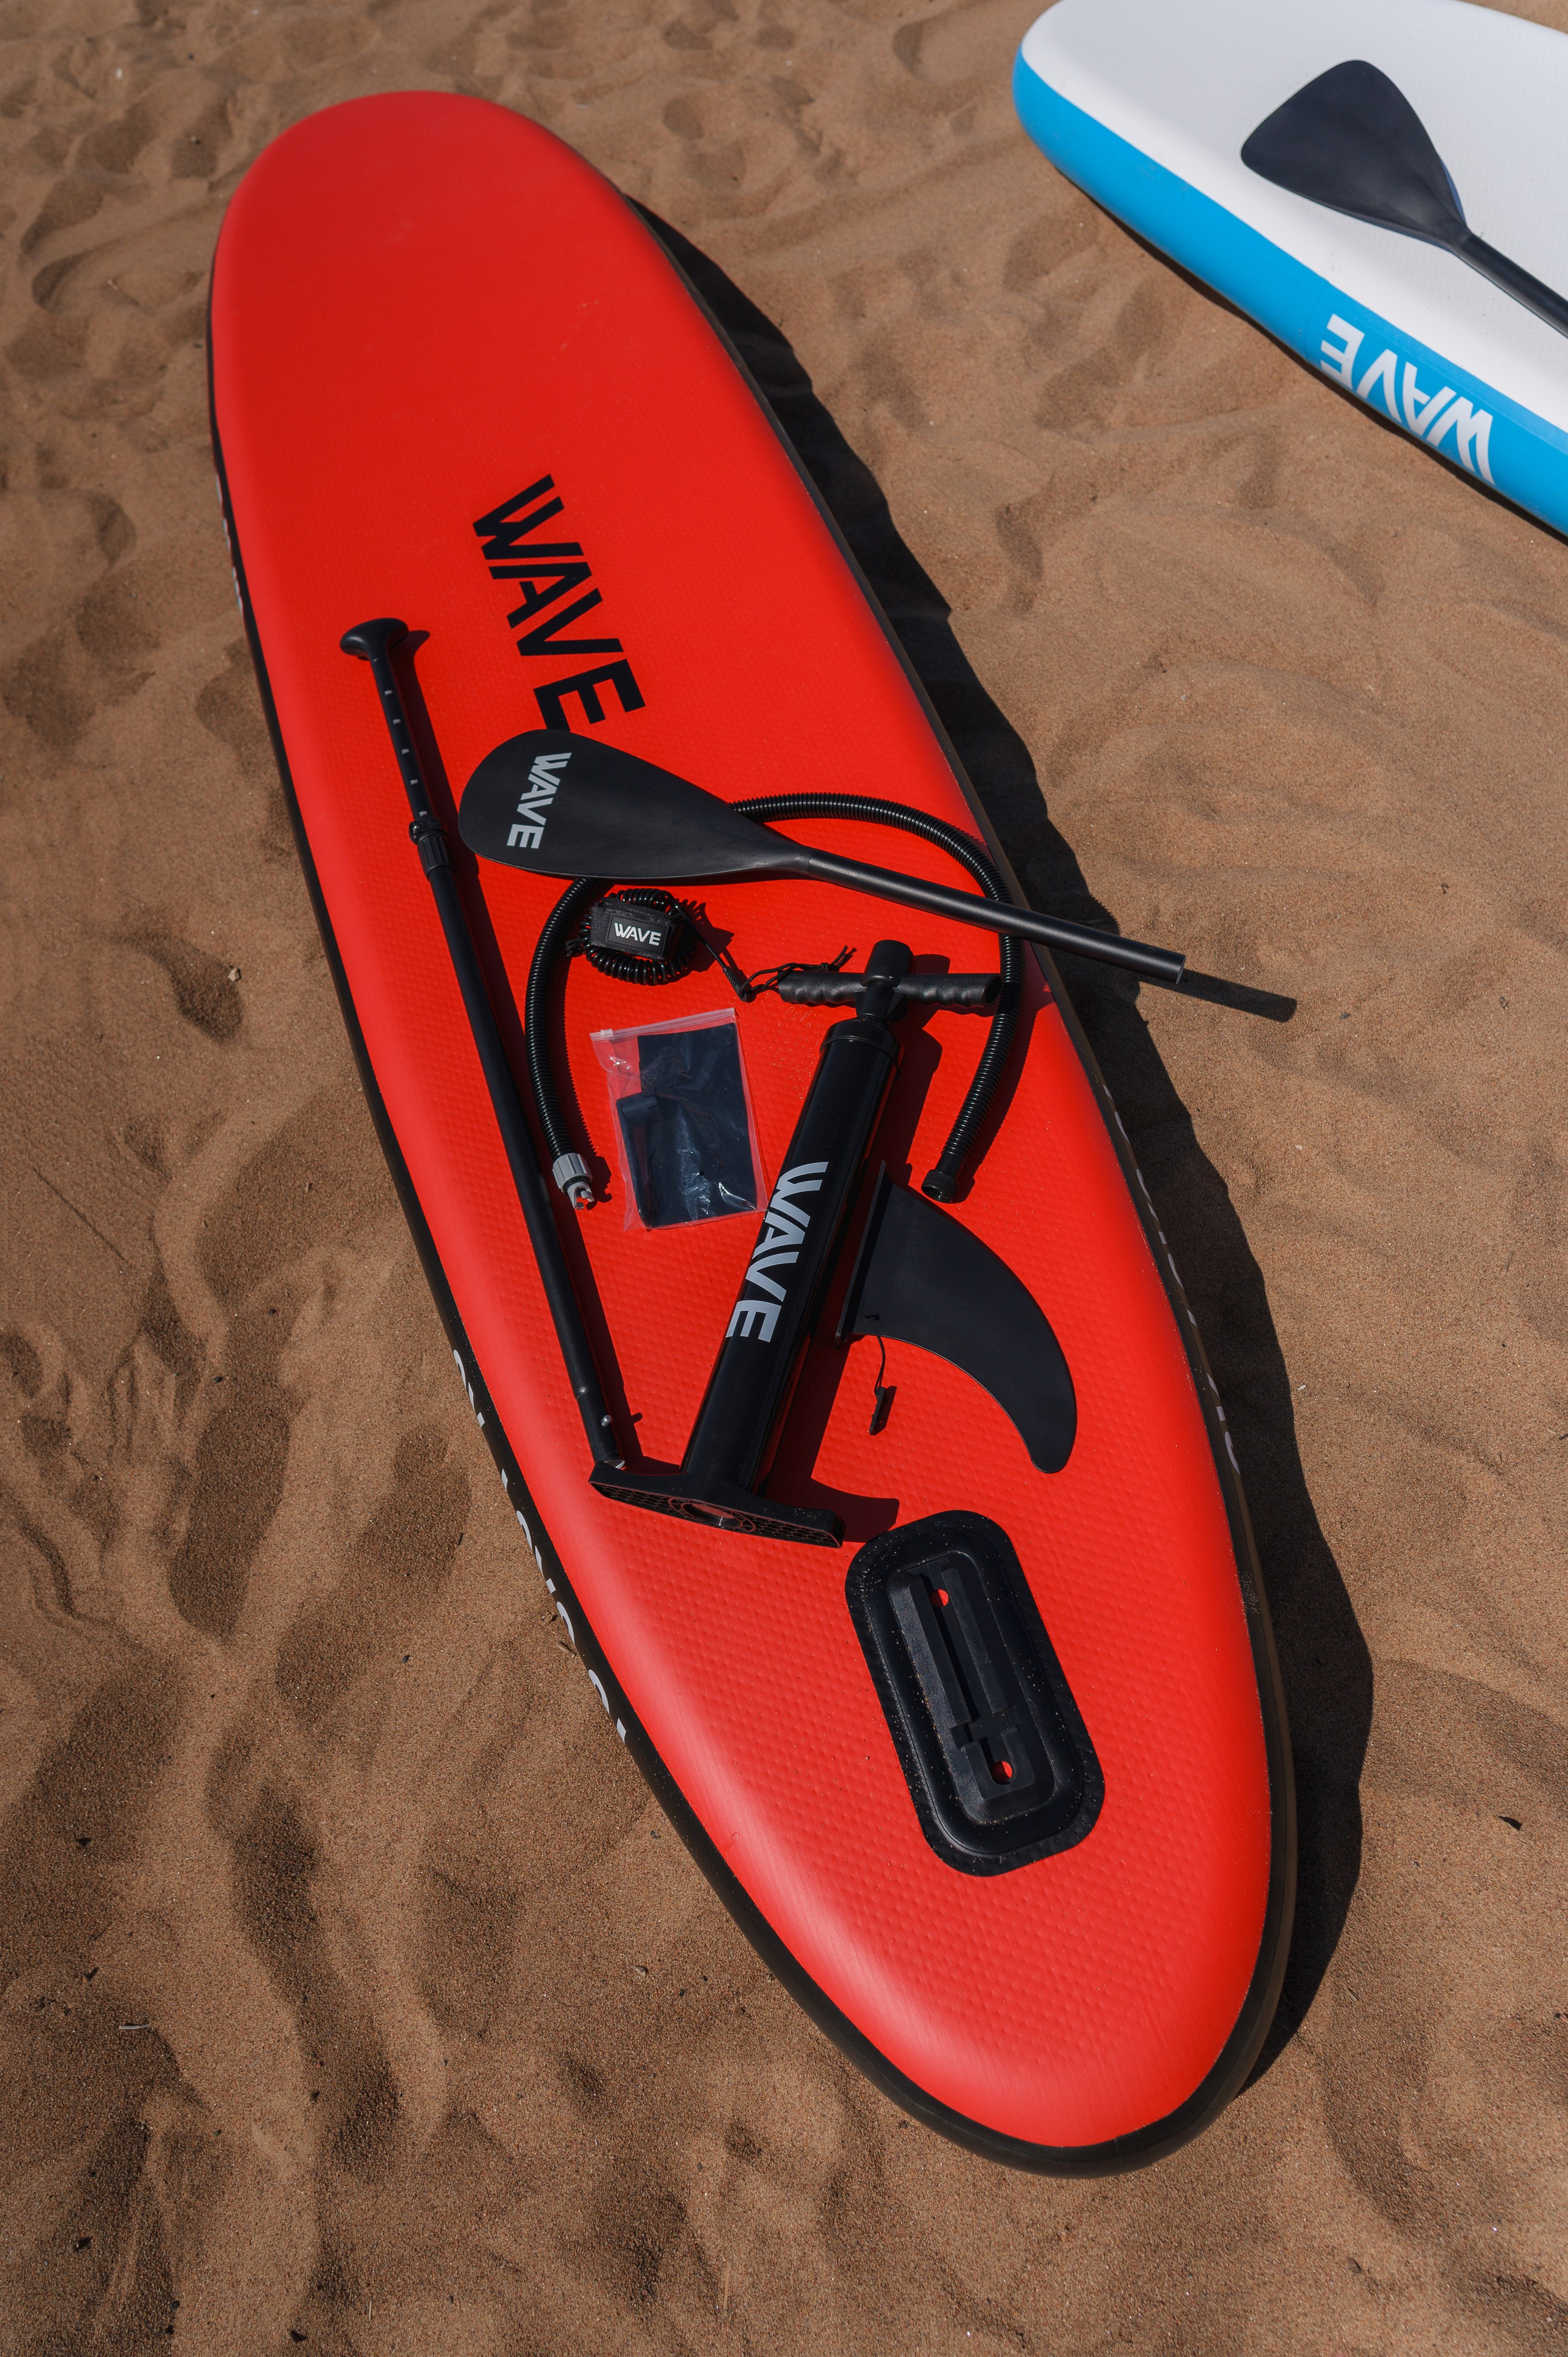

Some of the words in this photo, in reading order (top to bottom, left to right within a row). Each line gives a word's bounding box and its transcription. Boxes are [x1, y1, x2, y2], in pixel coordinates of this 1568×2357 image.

[1320, 313, 1495, 485] WAVE
[473, 473, 646, 731] WAVE
[507, 752, 572, 849] WAVE
[614, 922, 662, 946] WAVE
[726, 1161, 829, 1343] WAVE
